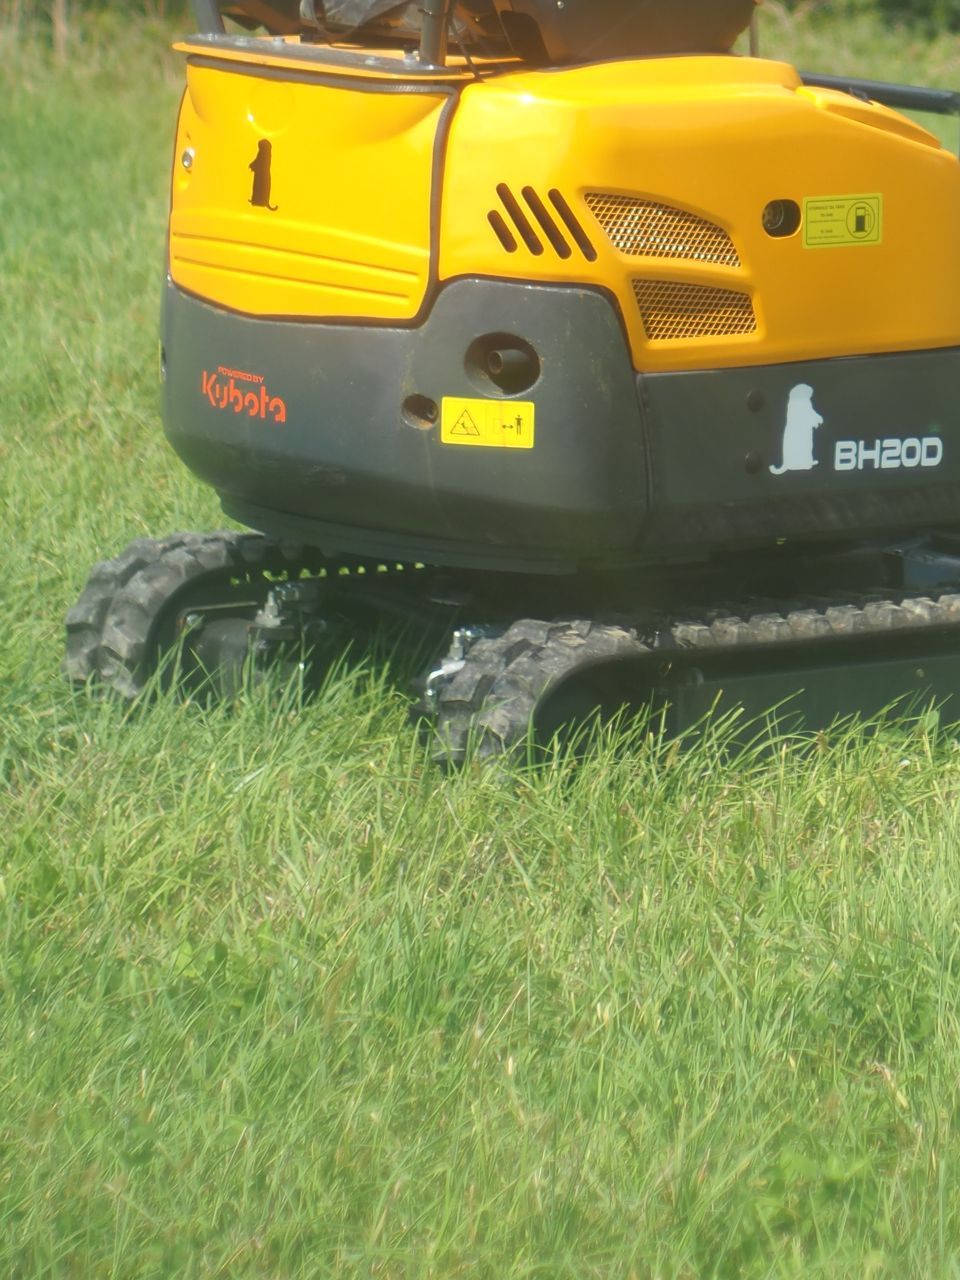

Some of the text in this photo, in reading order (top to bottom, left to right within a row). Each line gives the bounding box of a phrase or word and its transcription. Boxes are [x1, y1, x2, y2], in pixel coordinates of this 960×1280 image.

[217, 366, 265, 384] POWERED BY
[202, 370, 286, 423] Kubota
[834, 437, 943, 471] BH20D
